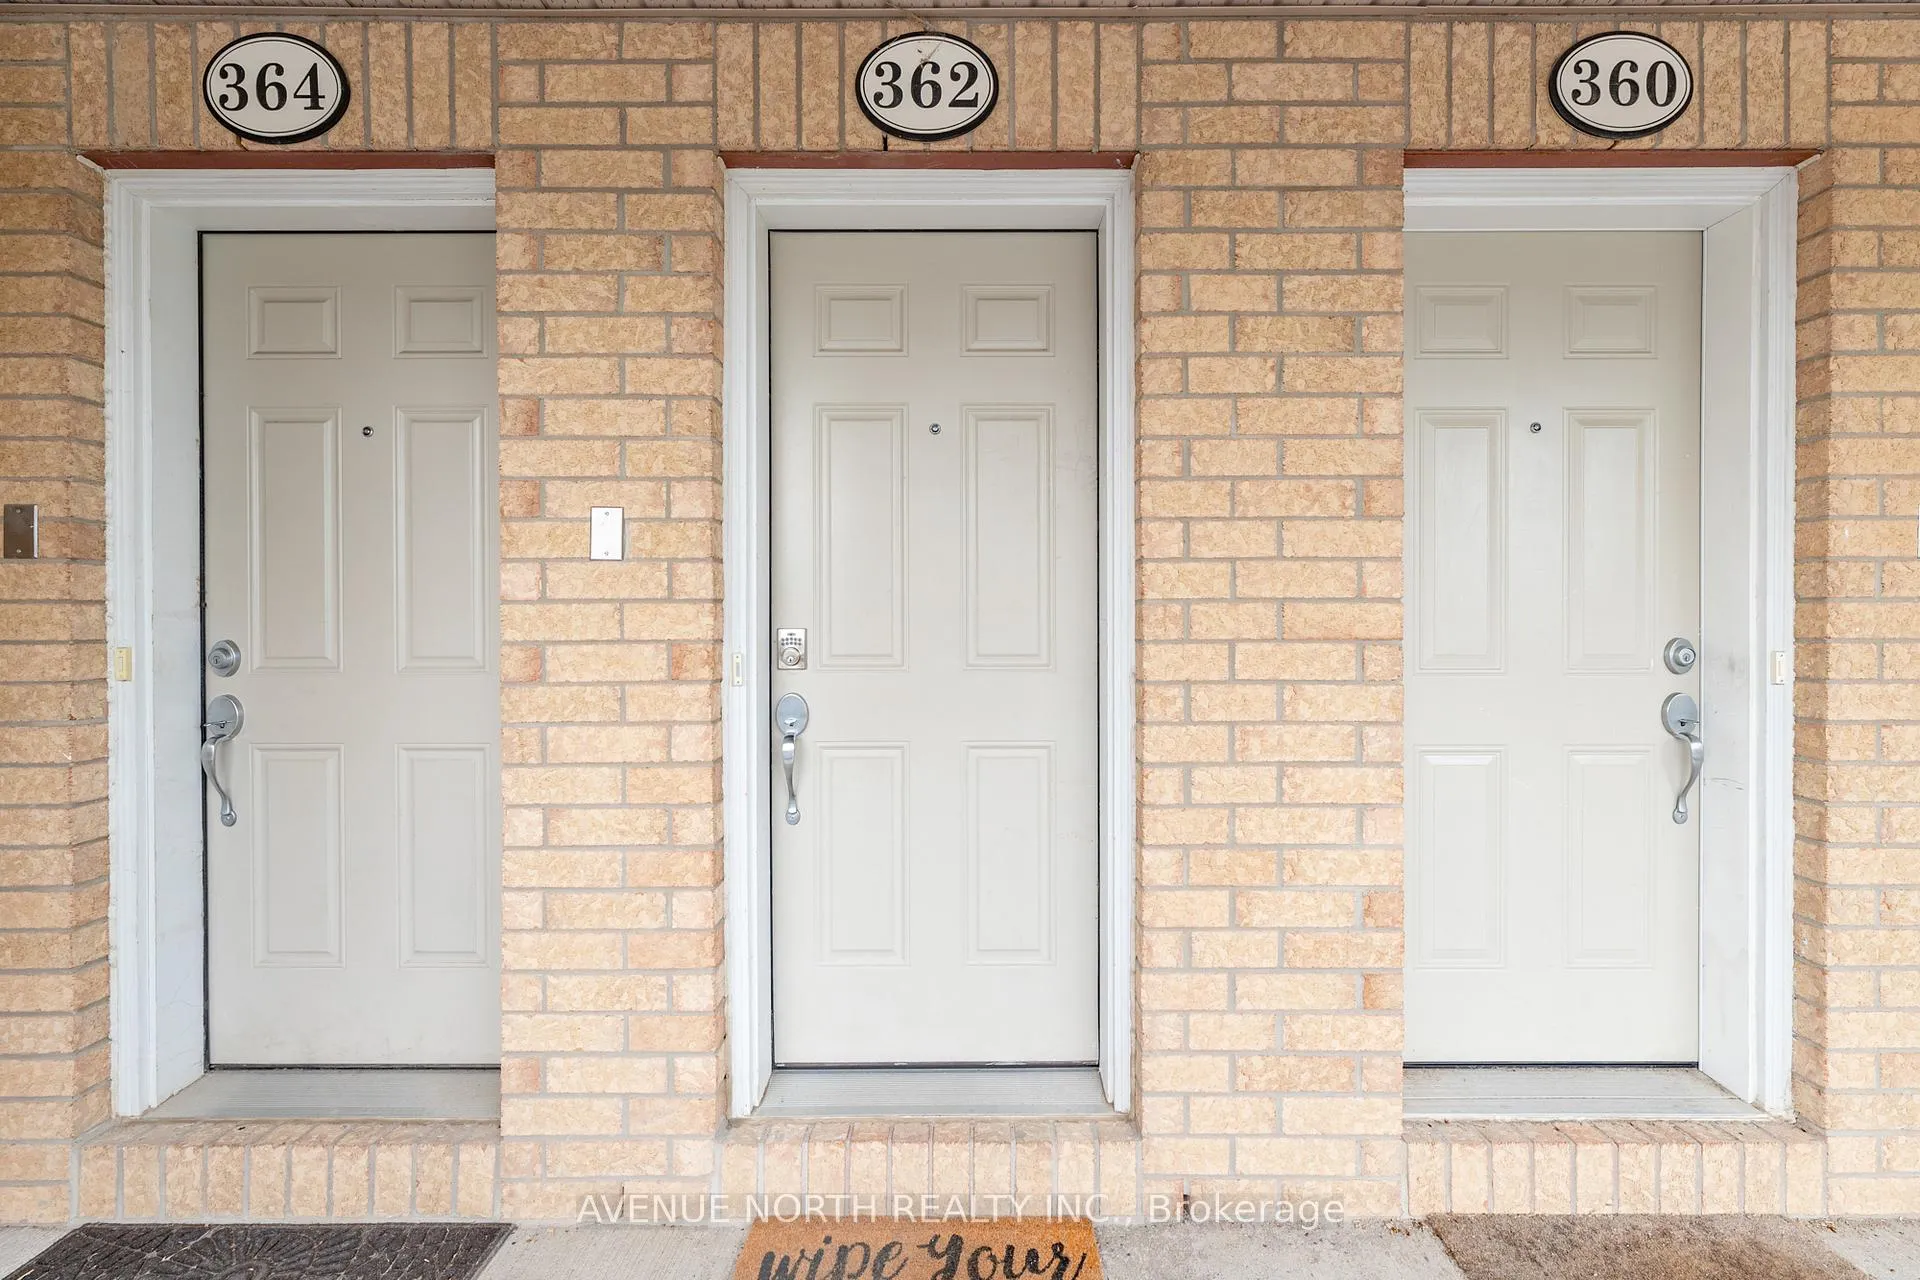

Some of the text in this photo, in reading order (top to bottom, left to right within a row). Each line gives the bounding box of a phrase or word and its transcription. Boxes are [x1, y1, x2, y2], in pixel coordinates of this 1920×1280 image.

[219, 62, 326, 112] 364
[873, 61, 979, 109] 362
[1571, 59, 1677, 107] 360
[757, 1235, 909, 1280] wipe
